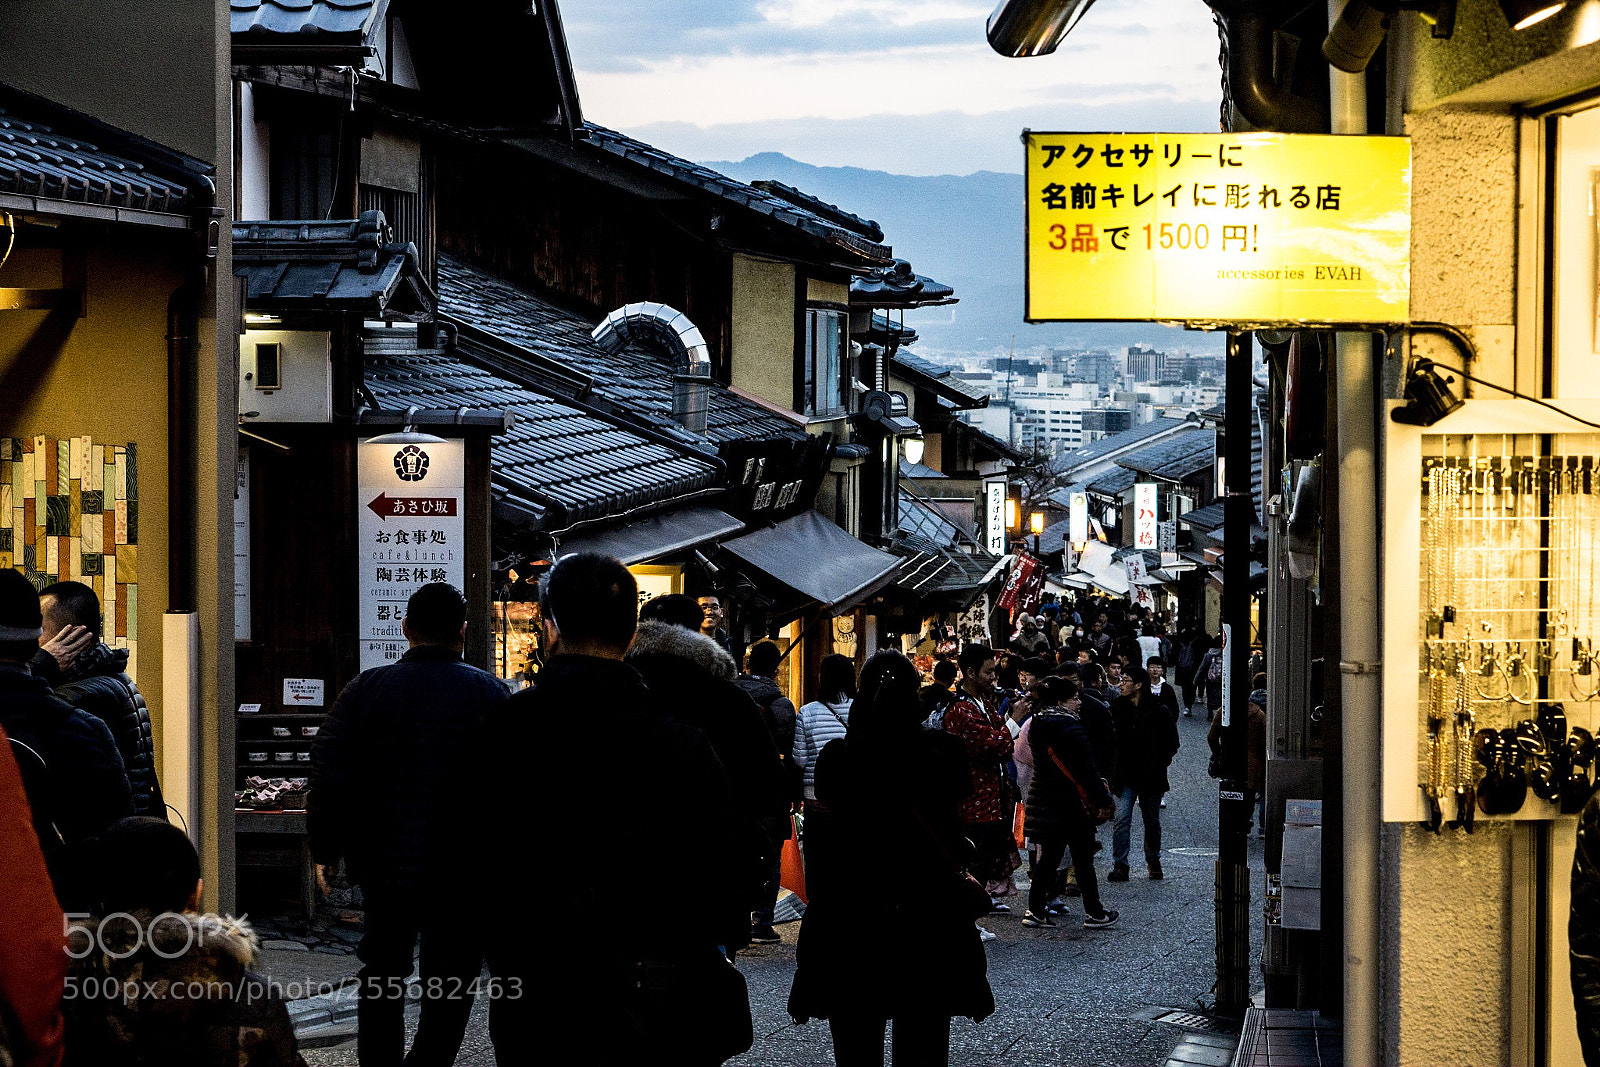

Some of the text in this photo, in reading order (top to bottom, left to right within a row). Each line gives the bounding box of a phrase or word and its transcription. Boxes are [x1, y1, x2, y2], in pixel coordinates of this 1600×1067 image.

[1041, 143, 1243, 168] アクセサリーに
[1041, 183, 1342, 211] 名前キレイに彫れる店
[1217, 266, 1362, 281] accessories EVAH
[393, 500, 449, 514] あさひ坂
[376, 529, 447, 545] お食事処
[376, 567, 448, 583] 陶芸体験
[377, 604, 409, 621] 器と
[372, 626, 404, 637] traditi
